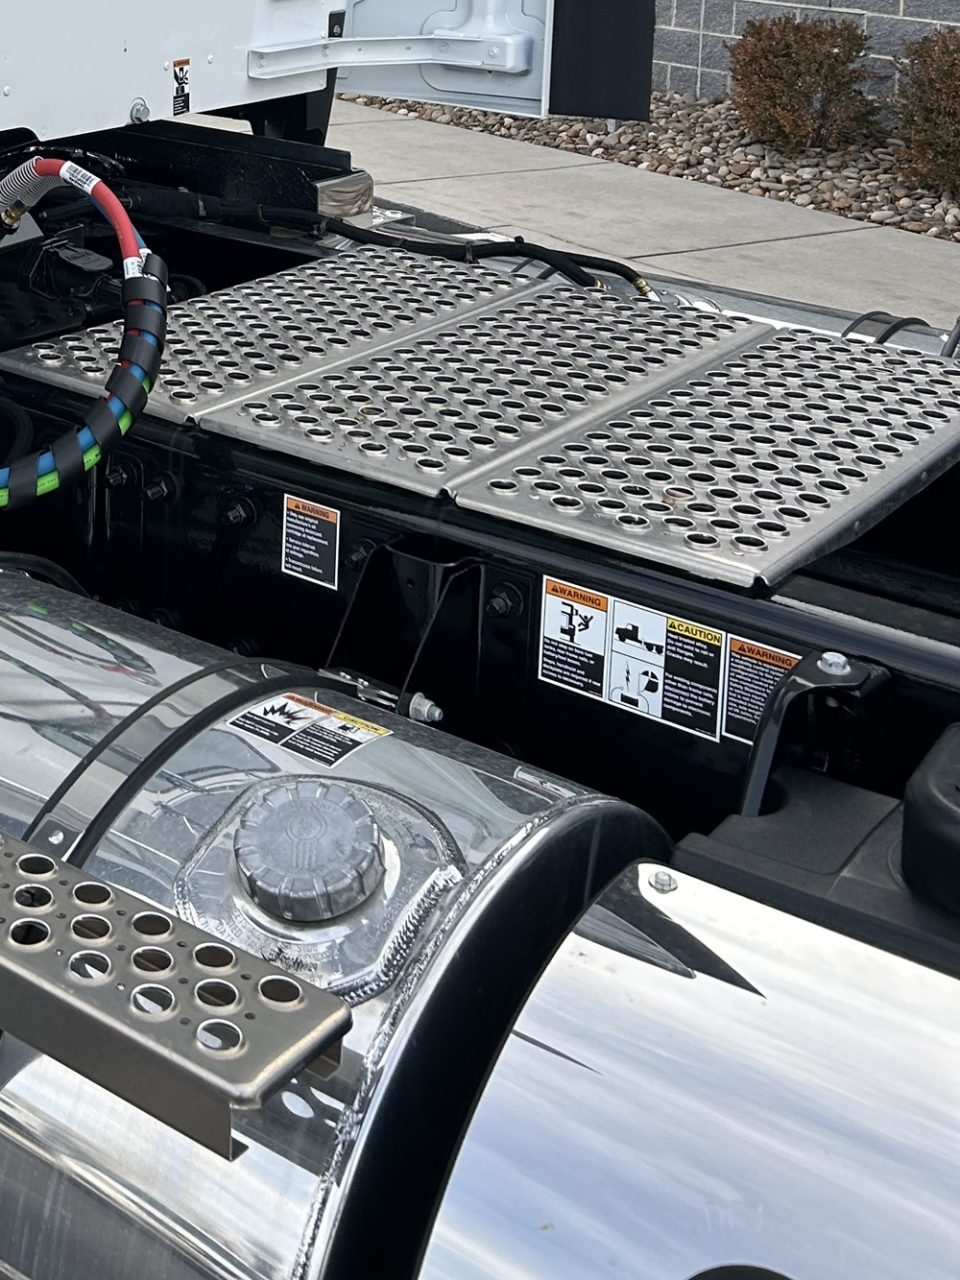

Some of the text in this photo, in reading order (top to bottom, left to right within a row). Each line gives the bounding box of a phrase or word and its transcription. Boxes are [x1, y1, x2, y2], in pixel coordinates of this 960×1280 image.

[301, 503, 330, 519] WARNING
[559, 586, 601, 607] WARNING
[676, 623, 721, 644] CAUTION
[746, 645, 793, 667] WARNING
